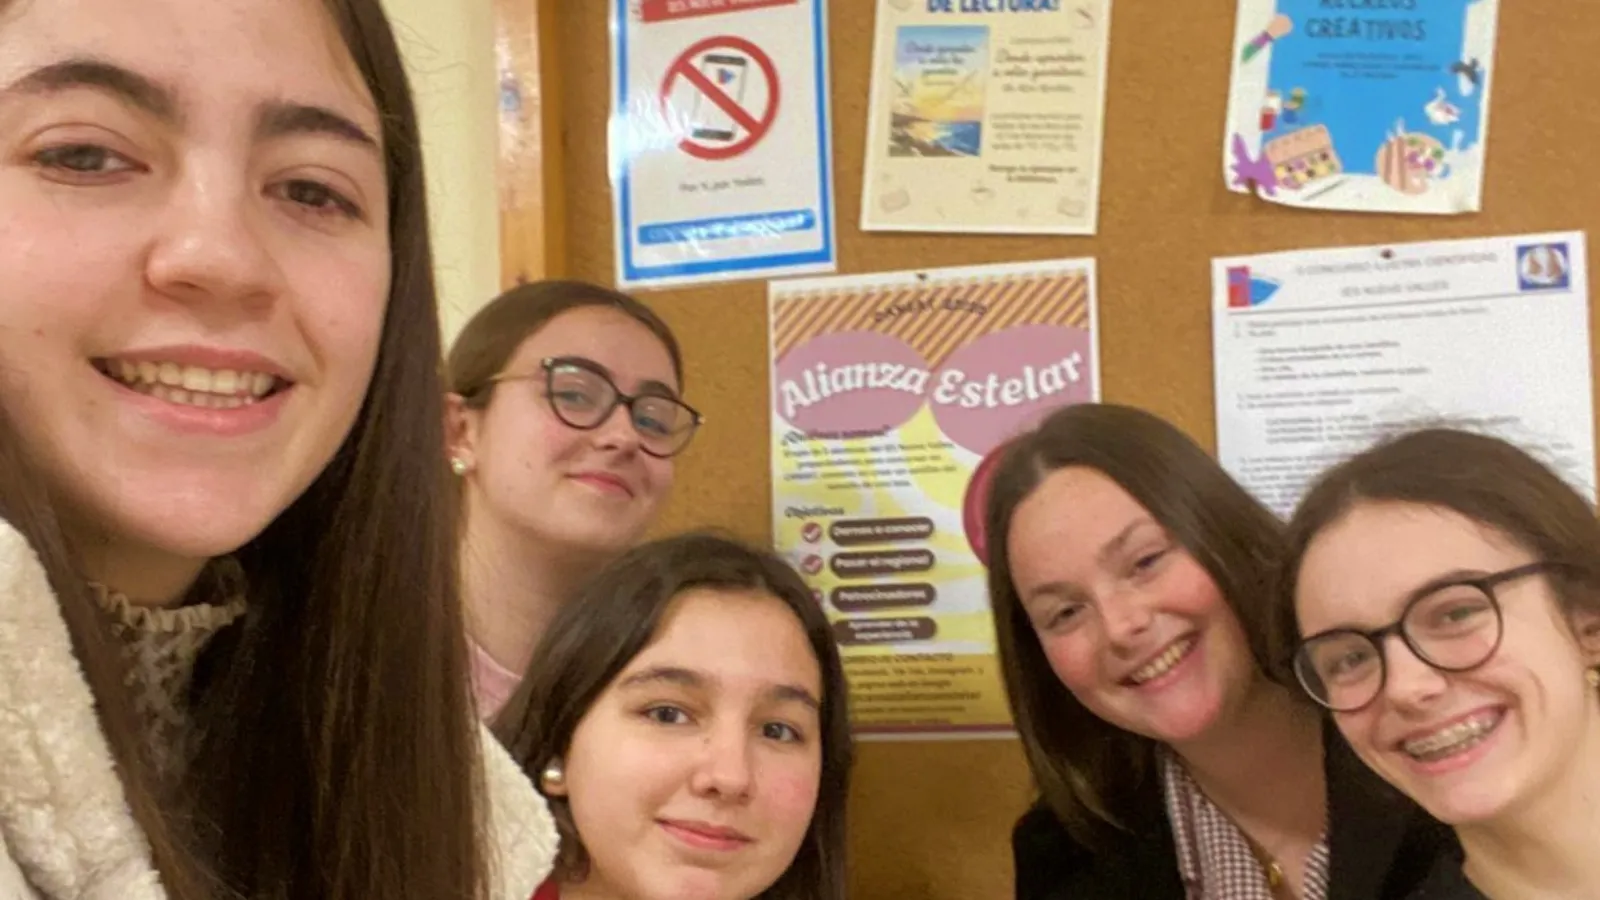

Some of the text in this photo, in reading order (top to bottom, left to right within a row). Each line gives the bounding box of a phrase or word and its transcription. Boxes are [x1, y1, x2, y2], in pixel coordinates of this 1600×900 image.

[1304, 16, 1427, 41] CREATIVOS
[780, 351, 1082, 418] Alianza Estelar
[839, 588, 927, 601] Patrocinadores
